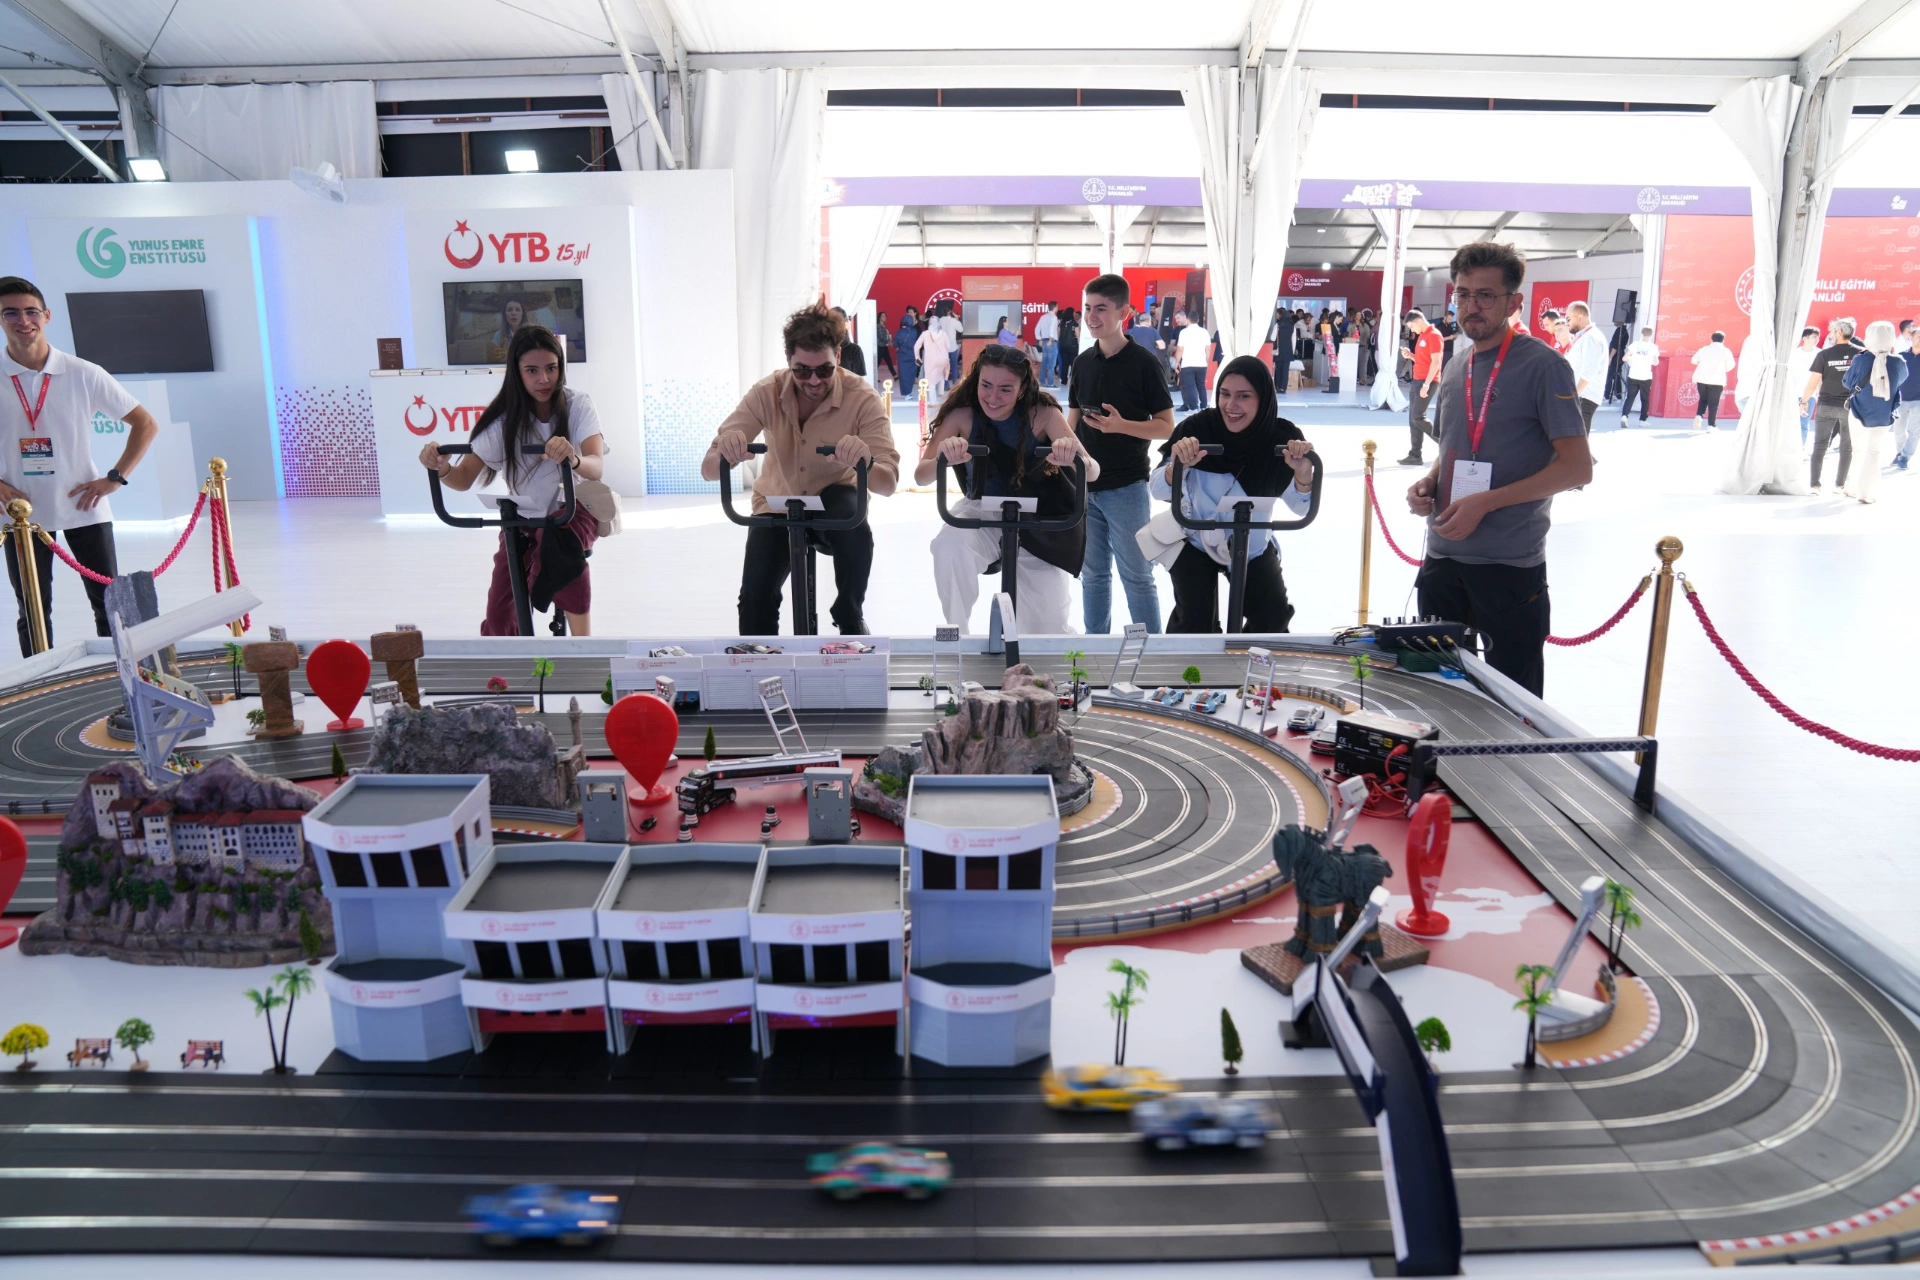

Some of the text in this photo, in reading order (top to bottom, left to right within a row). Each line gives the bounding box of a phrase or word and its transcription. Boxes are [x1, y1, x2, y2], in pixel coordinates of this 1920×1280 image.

[128, 239, 205, 251] YUNUS EMRE
[488, 232, 550, 264] YTB
[1840, 279, 1876, 290] EĞİTİM
